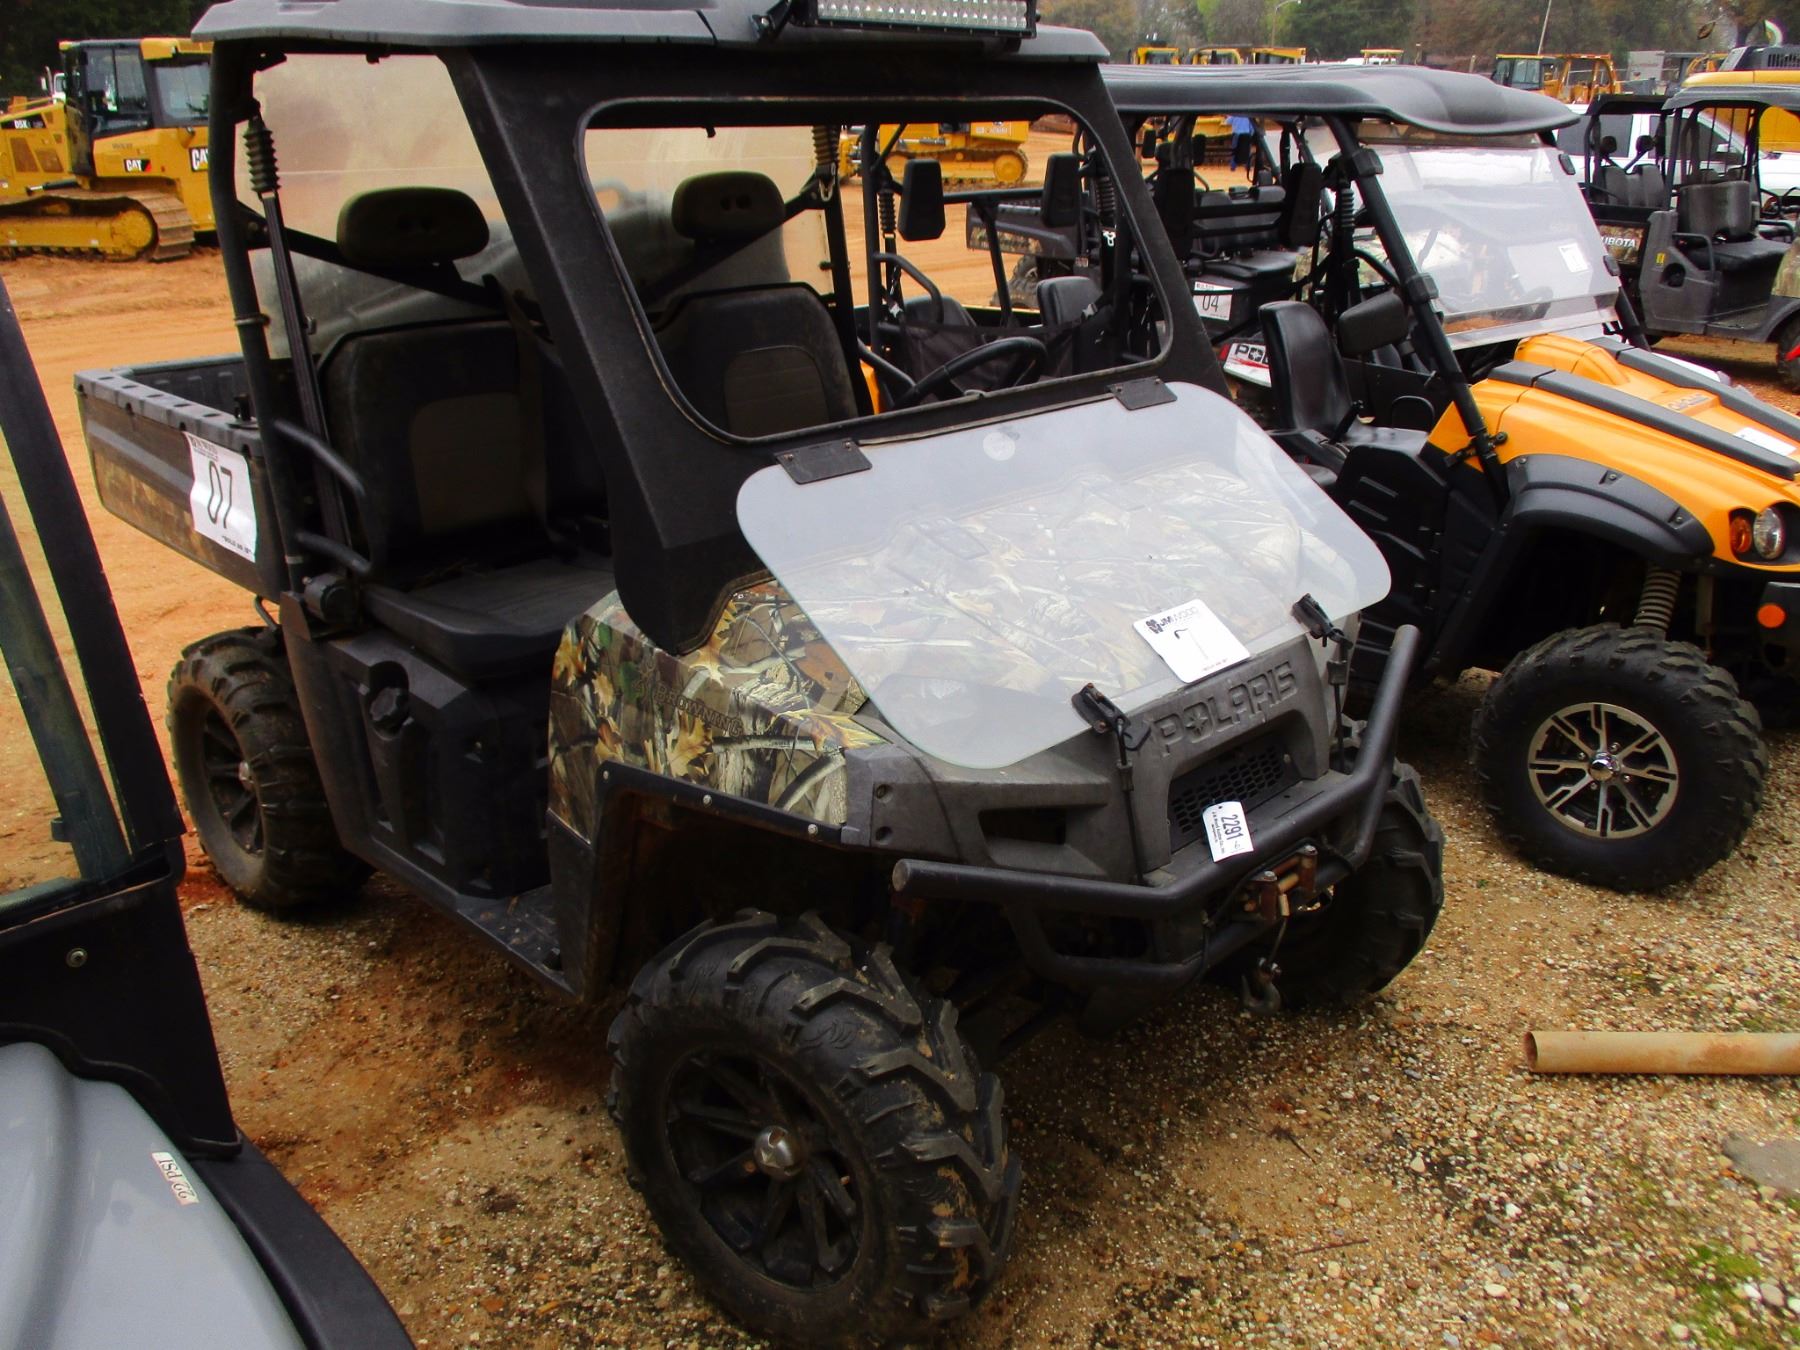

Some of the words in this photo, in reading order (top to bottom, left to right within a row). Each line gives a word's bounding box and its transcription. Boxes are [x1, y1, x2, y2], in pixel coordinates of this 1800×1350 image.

[126, 160, 142, 172] CAT
[1600, 236, 1636, 247] UBOTA
[207, 460, 233, 530] 07
[654, 682, 744, 738] BROWNING
[1152, 661, 1299, 757] POLARIS
[1221, 814, 1243, 840] 2291
[159, 1159, 183, 1179] PSI
[173, 1182, 196, 1199] 22
